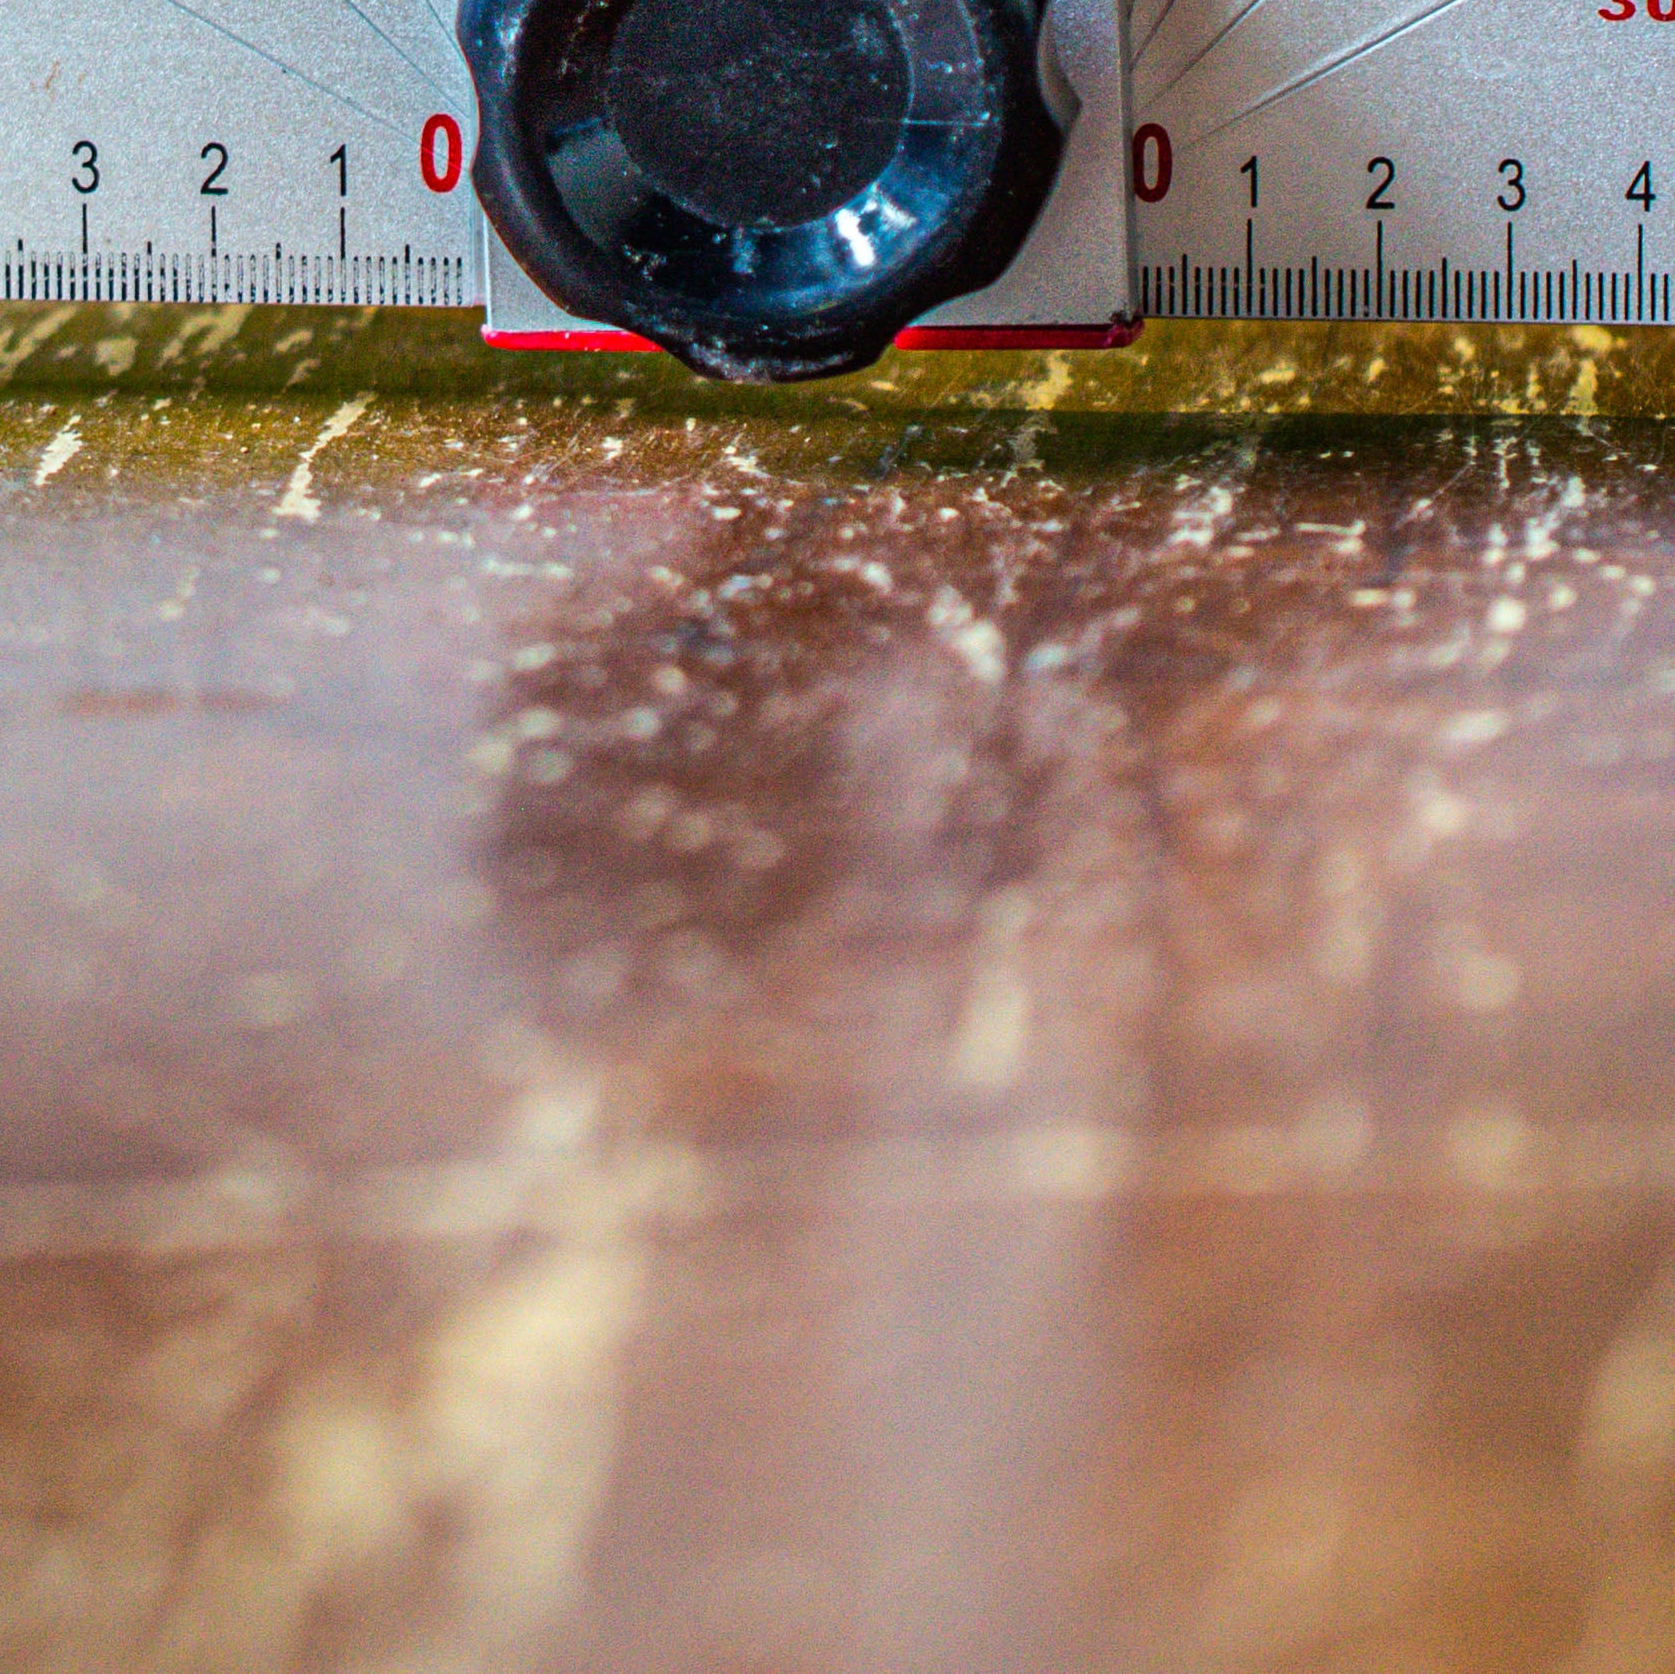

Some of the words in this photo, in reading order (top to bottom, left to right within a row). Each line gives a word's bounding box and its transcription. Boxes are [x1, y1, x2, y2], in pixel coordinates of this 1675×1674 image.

[71, 140, 100, 194] 3
[200, 142, 229, 196] 2
[329, 144, 347, 197] 1
[420, 113, 463, 194] 0
[1131, 122, 1173, 203] 0
[1240, 155, 1258, 208] 1
[1365, 156, 1395, 210] 2
[1496, 158, 1526, 212] 3
[1624, 160, 1656, 212] 4
